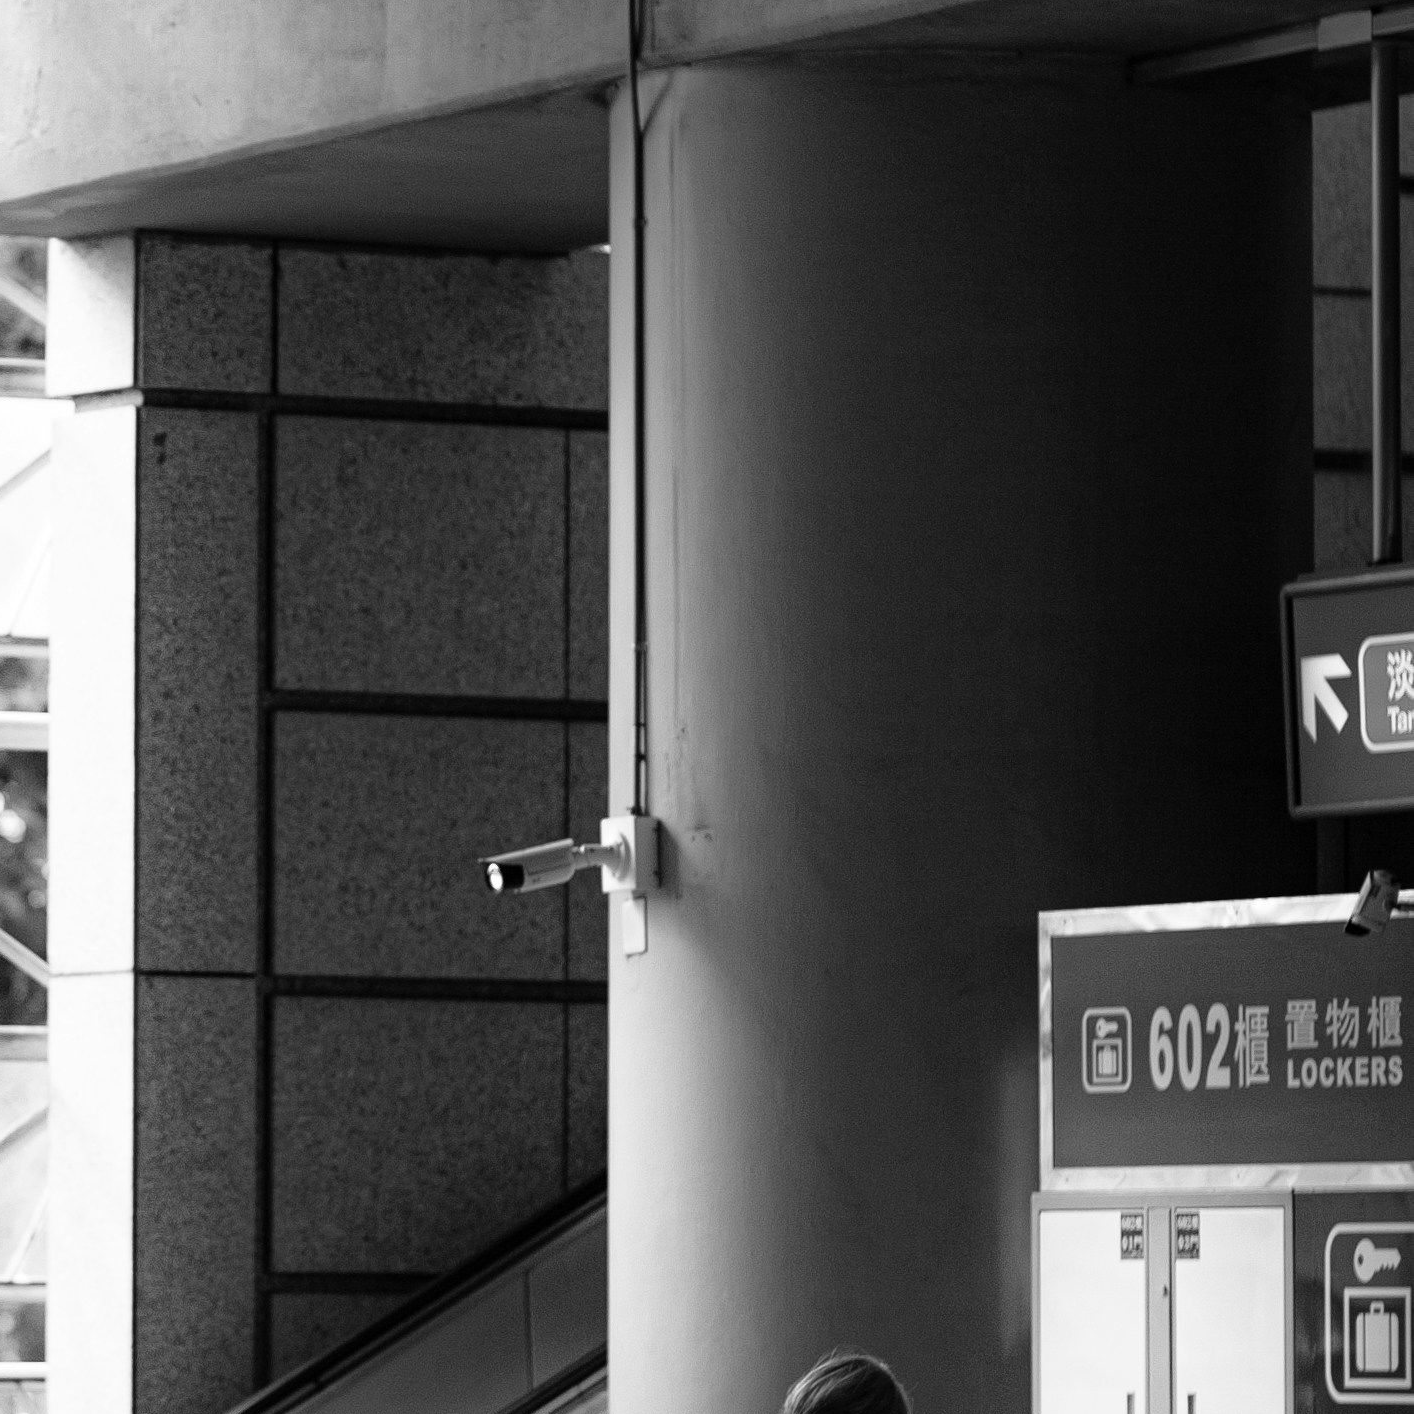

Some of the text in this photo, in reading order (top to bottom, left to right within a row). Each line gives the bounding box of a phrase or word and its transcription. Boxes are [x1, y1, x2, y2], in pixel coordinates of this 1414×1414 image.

[1149, 1001, 1270, 1091] 602櫃
[1285, 996, 1403, 1051] 置物櫃
[1286, 1055, 1403, 1089] LOCKERS
